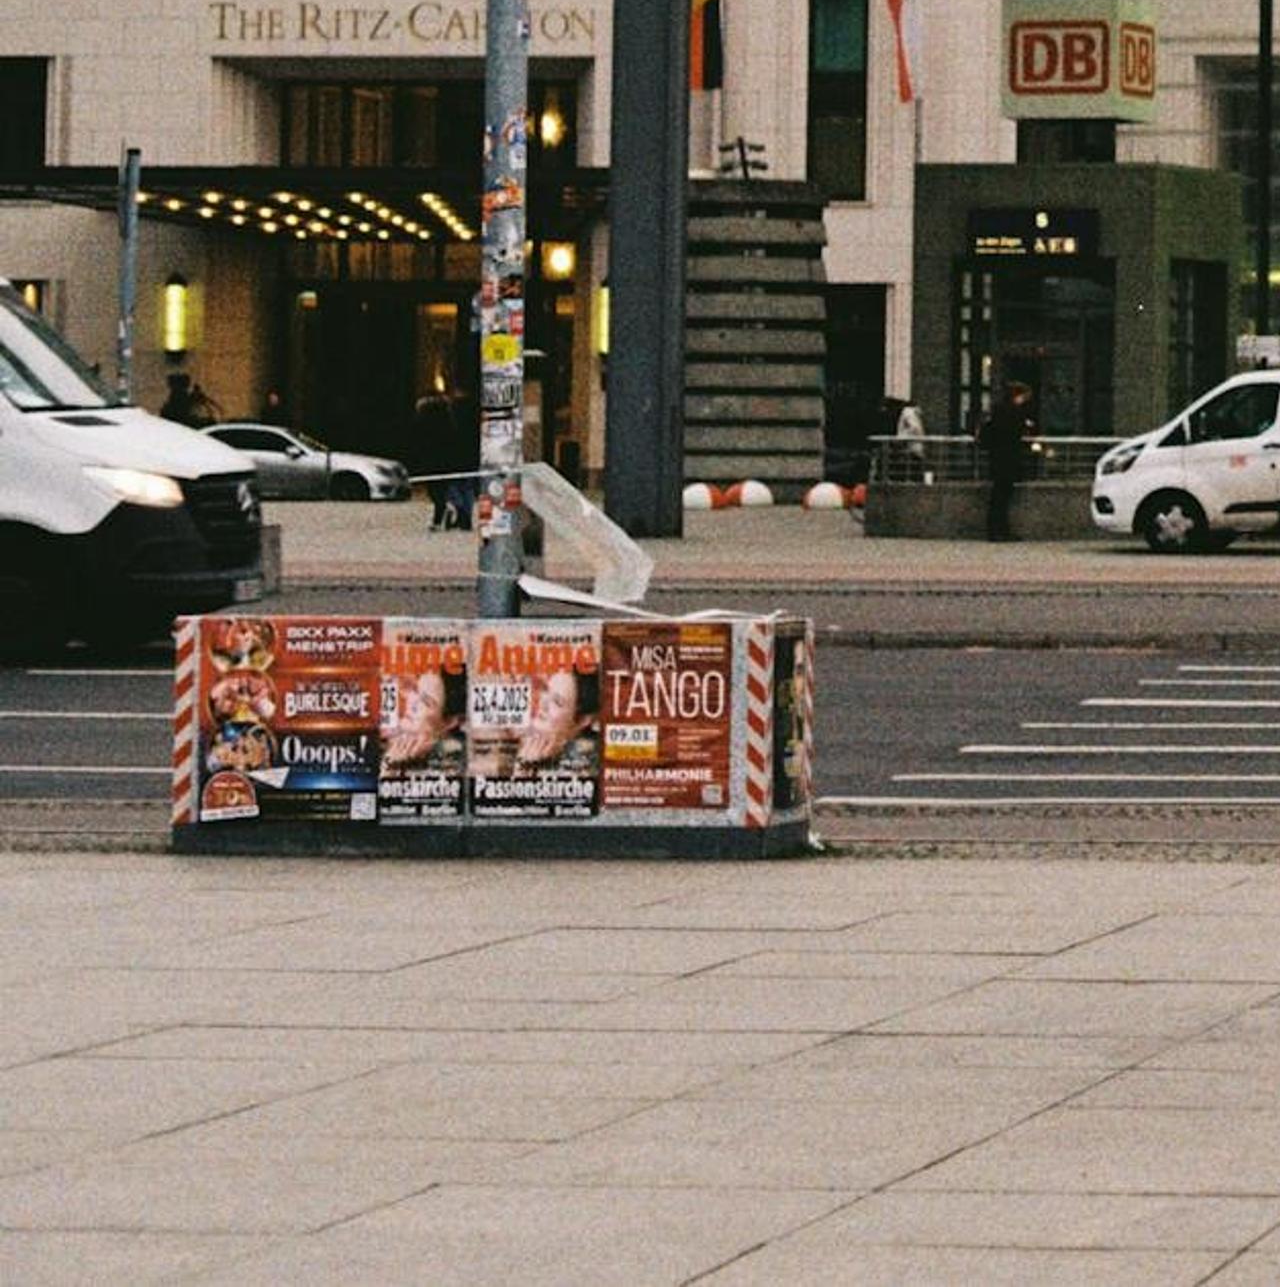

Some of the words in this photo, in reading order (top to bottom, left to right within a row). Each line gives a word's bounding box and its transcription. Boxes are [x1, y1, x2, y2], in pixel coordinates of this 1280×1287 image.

[209, 3, 284, 40] THE
[299, 3, 596, 41] RITZ-CAON
[1021, 31, 1099, 84] DB
[1123, 34, 1151, 87] DB
[478, 634, 597, 675] Anime
[537, 632, 593, 644] Konzert
[631, 645, 677, 671] MISA
[284, 692, 371, 717] BURLESQUE
[605, 670, 725, 718] TANGO
[281, 735, 368, 773] Ooops!
[474, 774, 596, 799] Passionskirche
[604, 767, 713, 782] PHILHARMONIE
